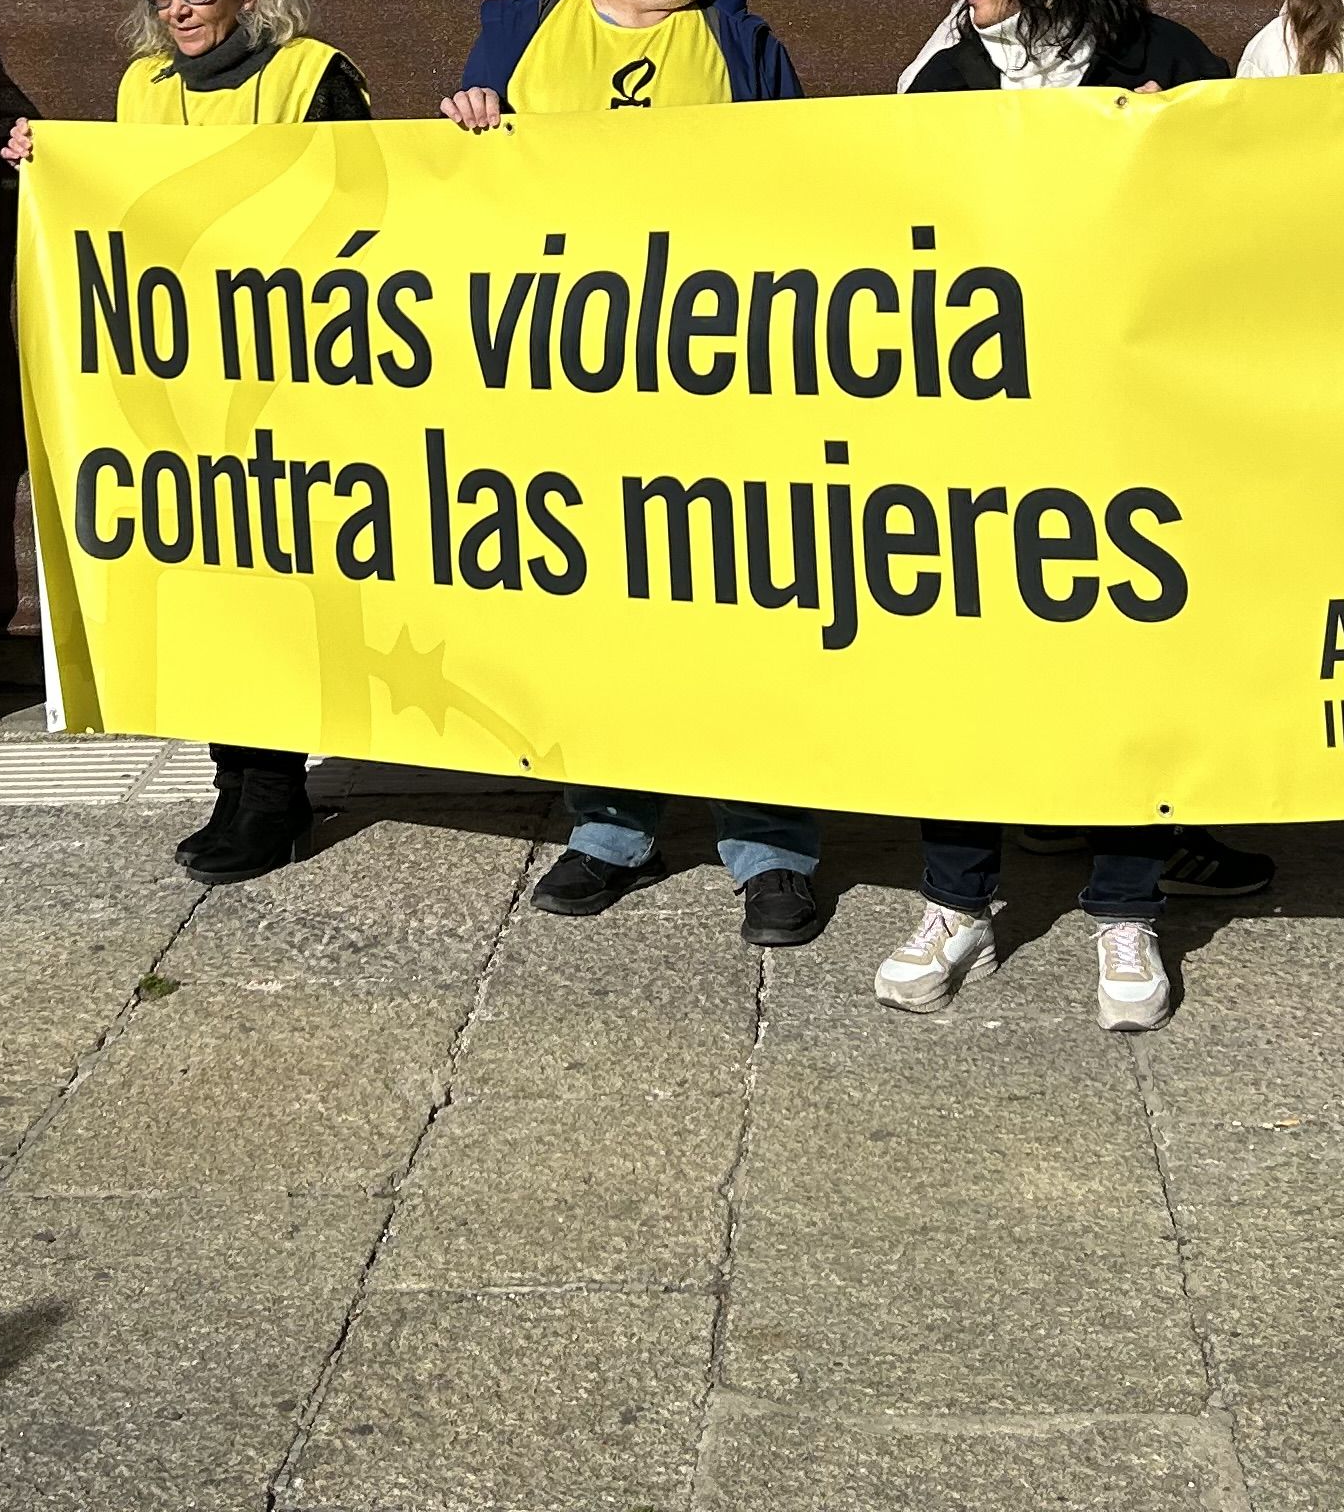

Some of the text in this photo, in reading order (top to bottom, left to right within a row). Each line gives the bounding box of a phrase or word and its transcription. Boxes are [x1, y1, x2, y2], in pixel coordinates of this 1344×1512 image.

[75, 226, 1031, 400] No más violencia
[75, 428, 1188, 650] contra las mujeres
